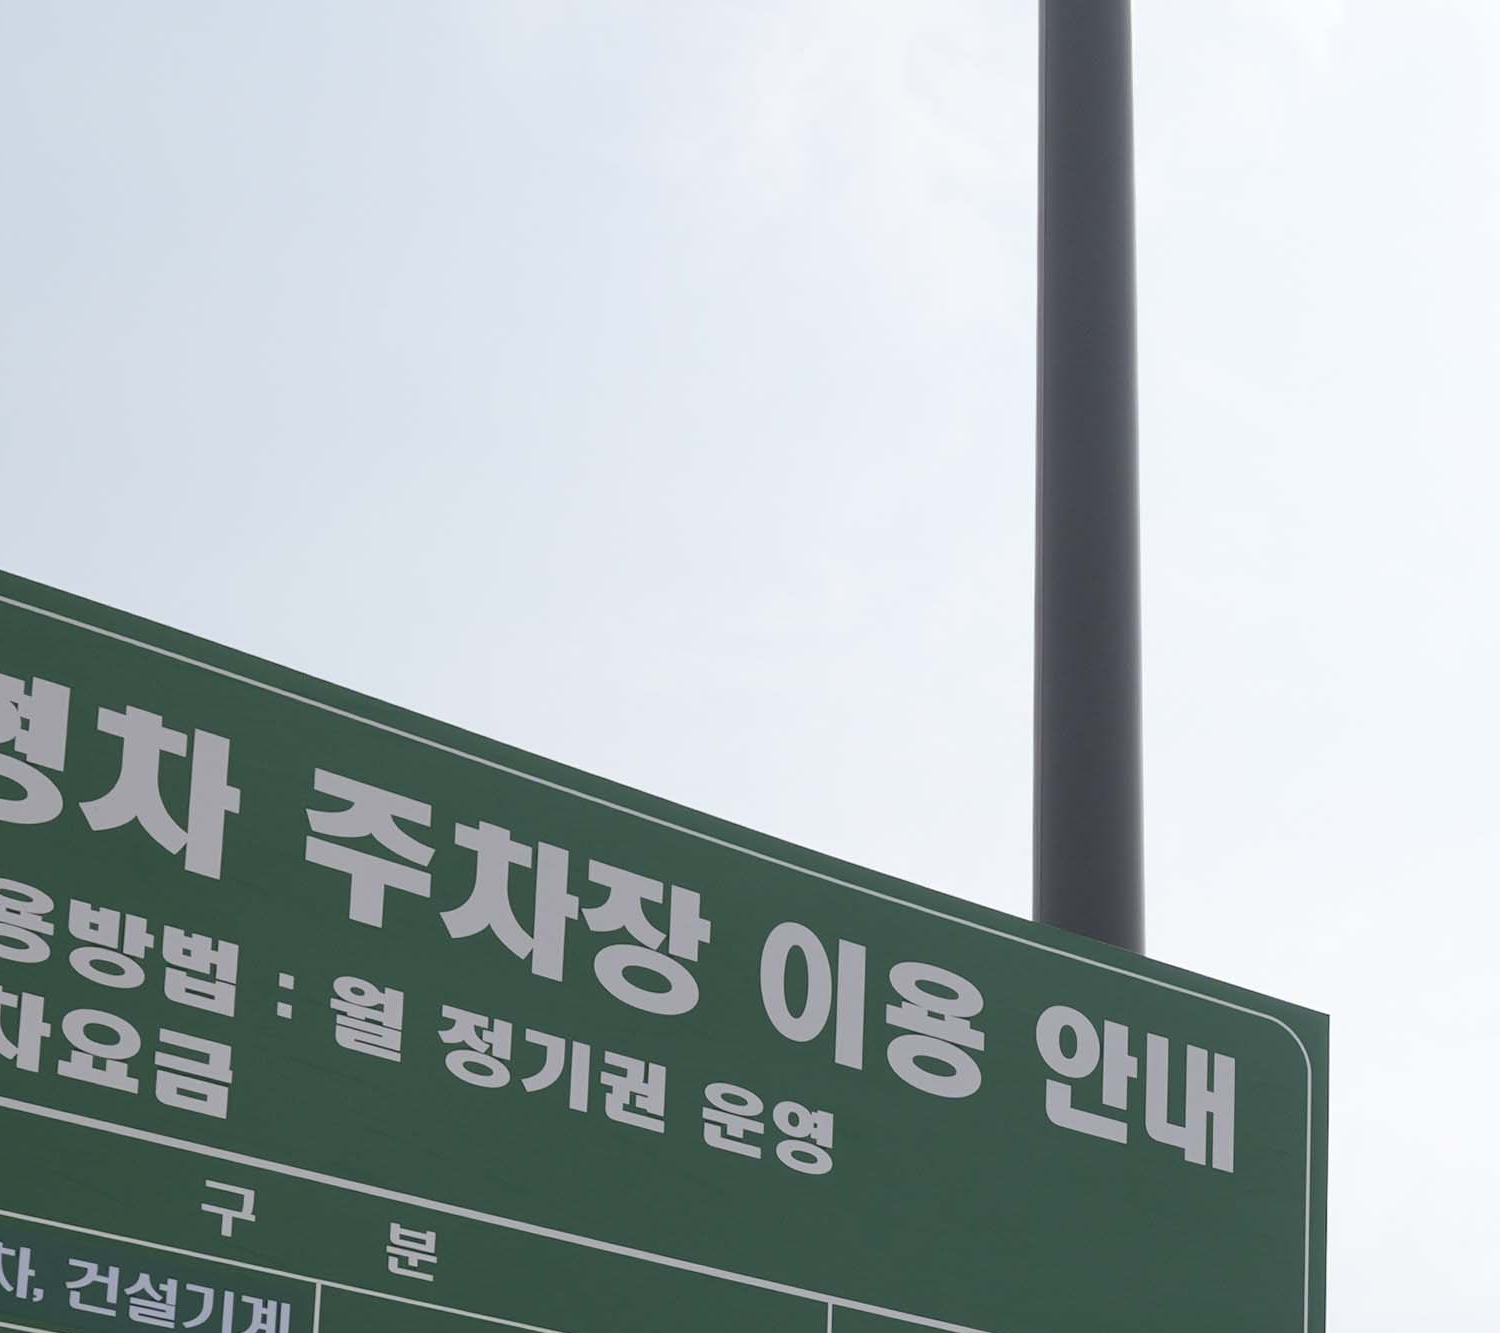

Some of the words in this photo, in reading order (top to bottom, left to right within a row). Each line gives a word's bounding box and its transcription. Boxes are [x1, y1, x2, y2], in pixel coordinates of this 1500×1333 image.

[305, 767, 712, 1016] 주차장
[760, 921, 985, 1099] 이용
[1035, 1005, 1236, 1174] 안내
[330, 976, 405, 1063] 월
[437, 1004, 667, 1134] 정기권
[702, 1082, 834, 1175] 운영
